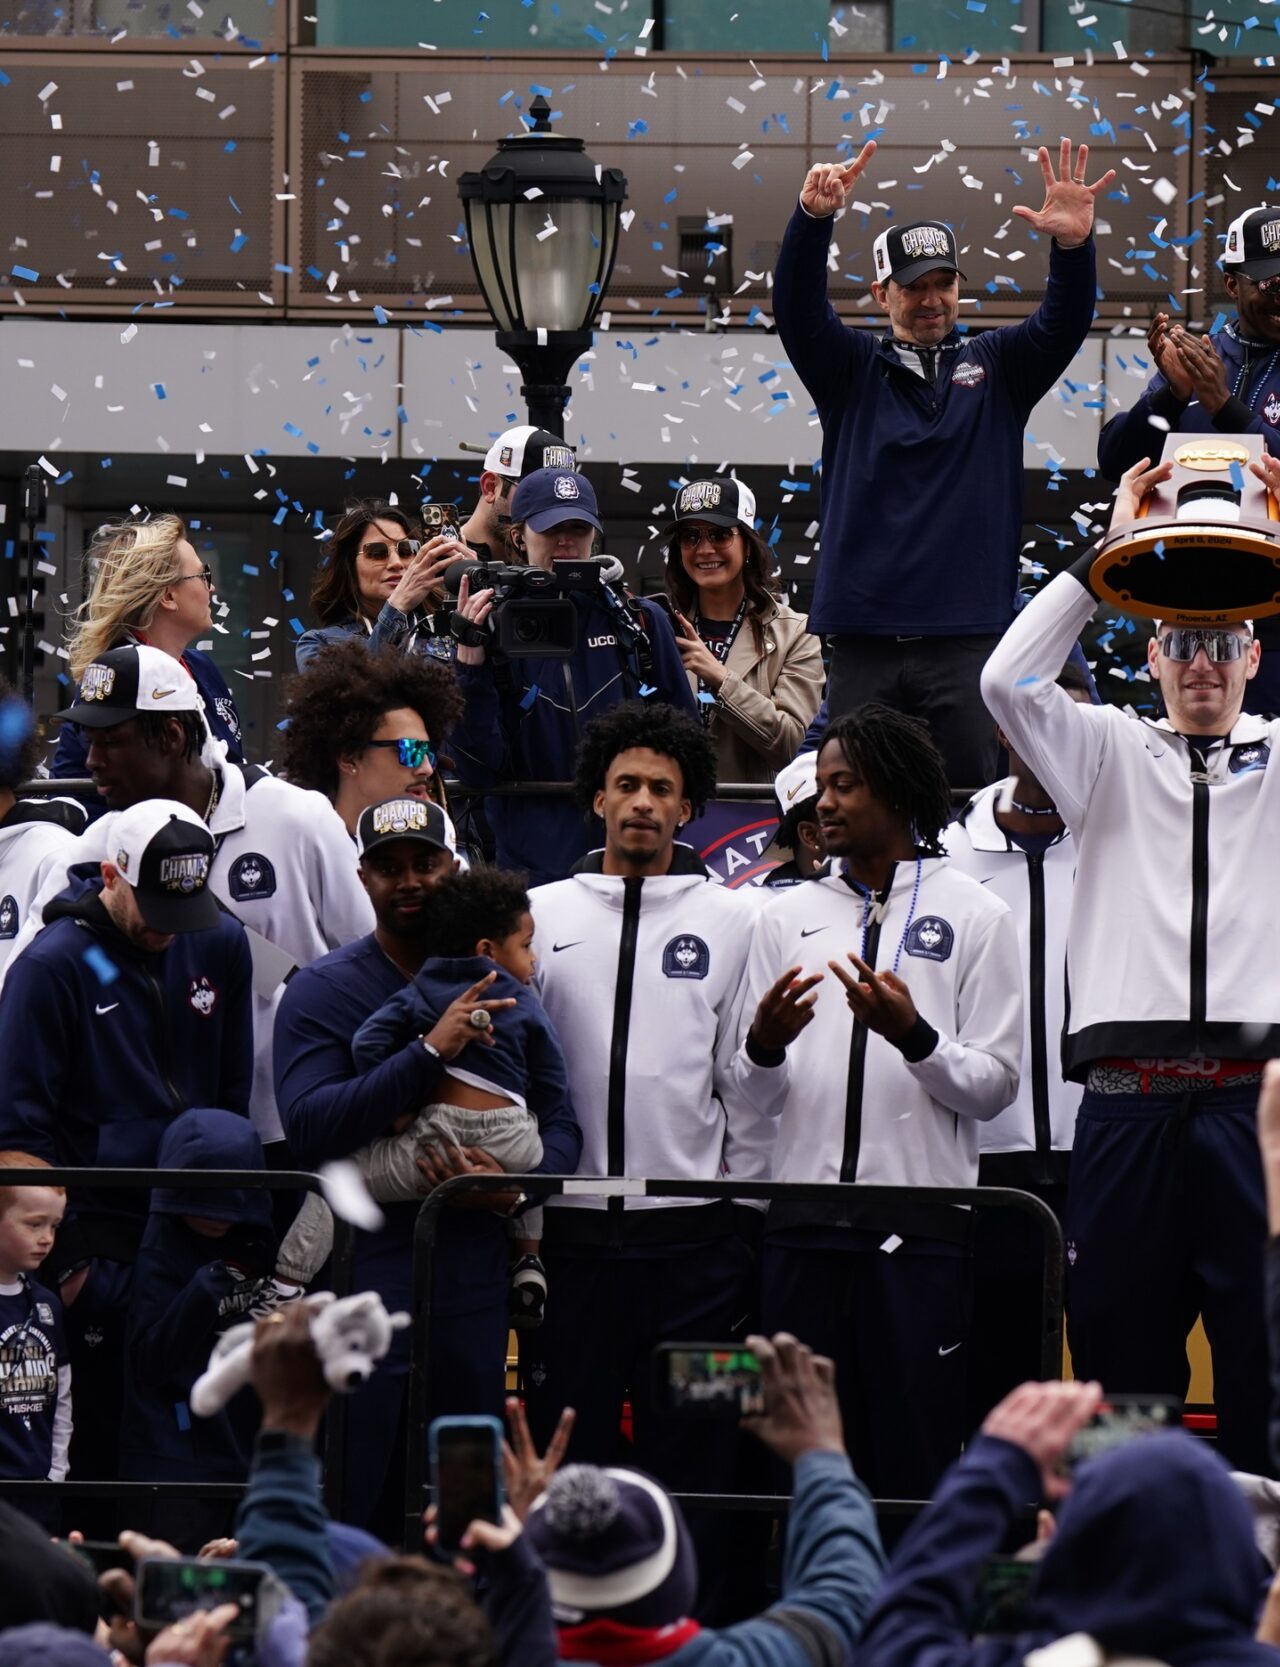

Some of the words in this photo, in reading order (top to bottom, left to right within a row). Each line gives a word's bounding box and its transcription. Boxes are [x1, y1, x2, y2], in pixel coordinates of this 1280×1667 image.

[901, 231, 950, 255] CHAMPS
[681, 483, 721, 509] CHAMPS
[588, 635, 618, 648] UCO
[373, 803, 427, 831] CHAMPS
[160, 856, 209, 881] CHAMPS
